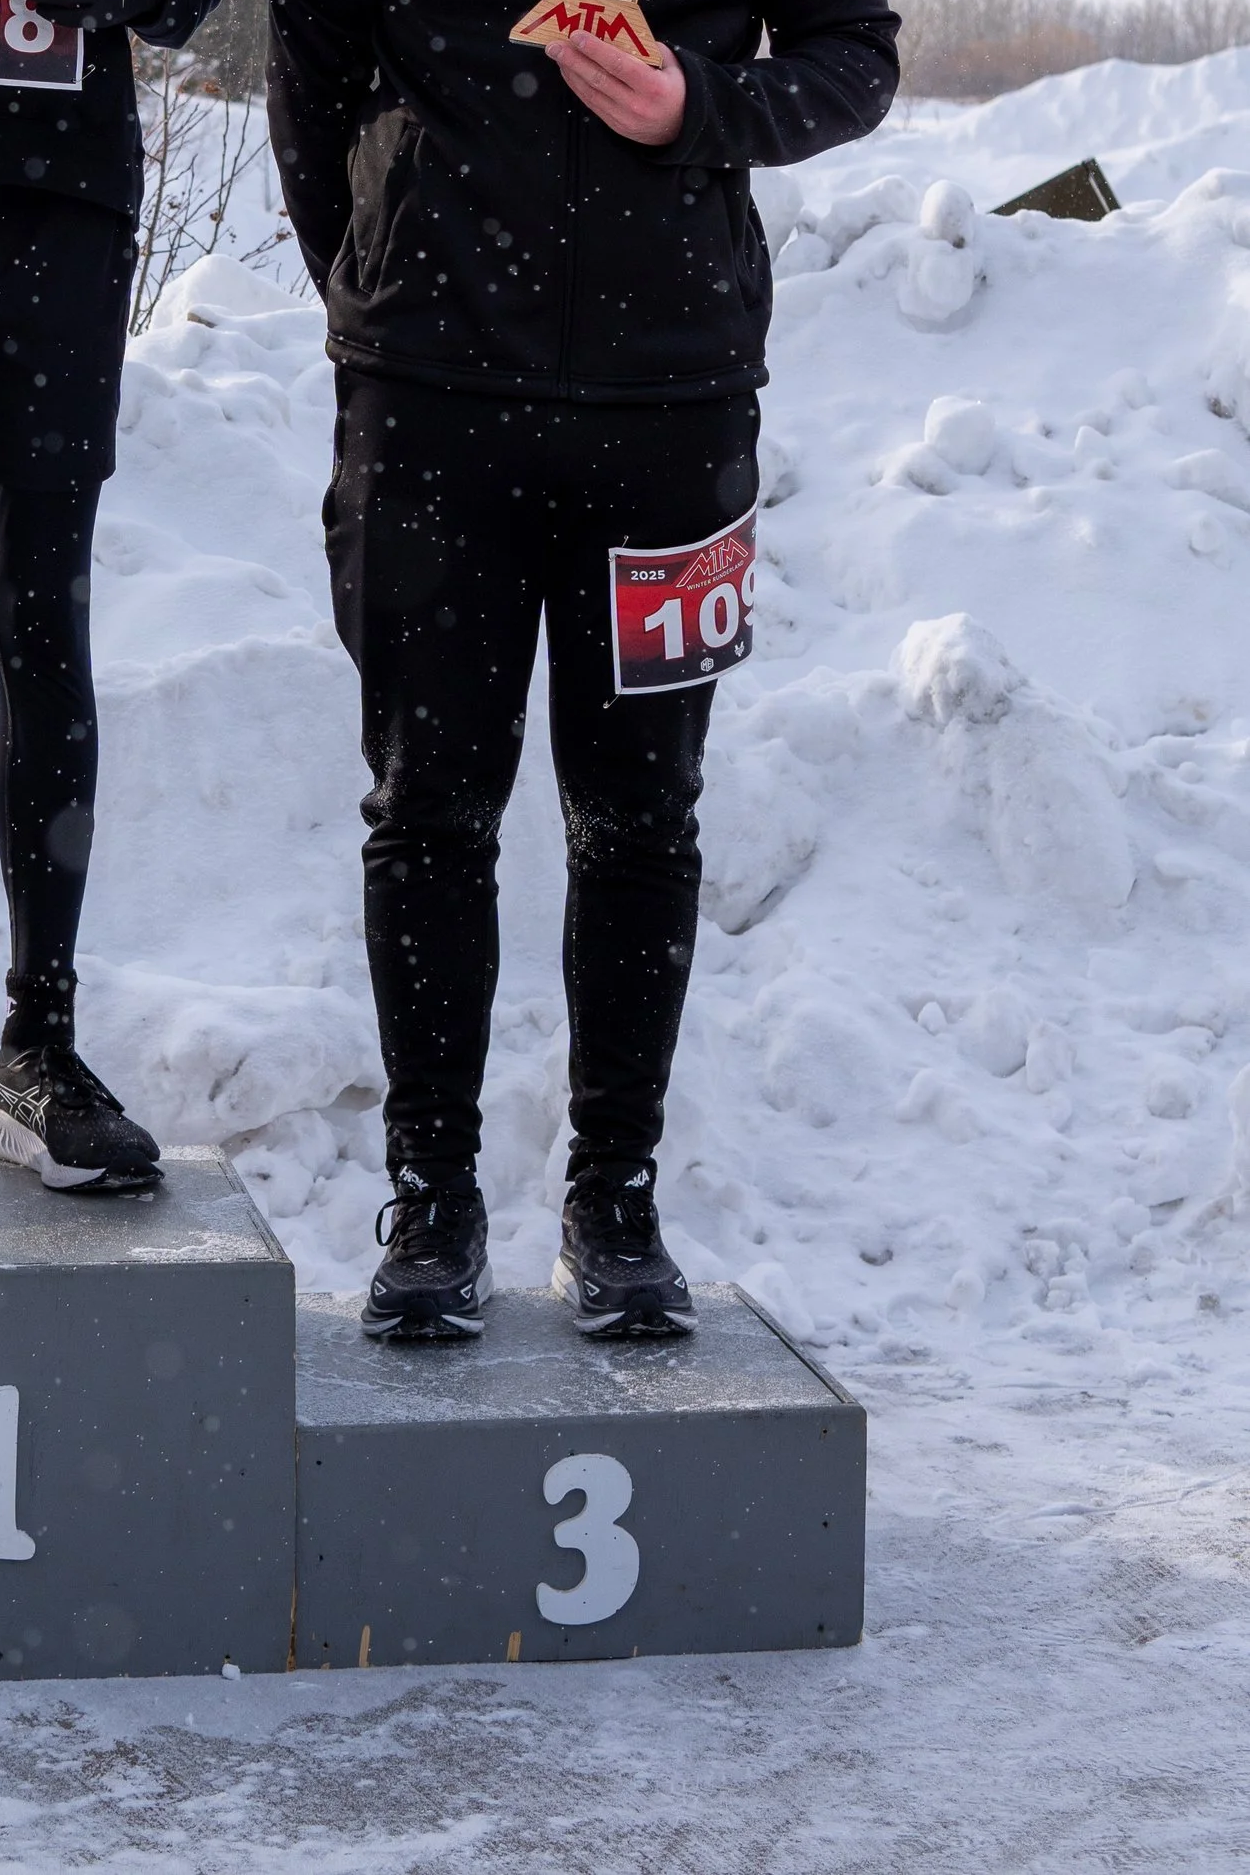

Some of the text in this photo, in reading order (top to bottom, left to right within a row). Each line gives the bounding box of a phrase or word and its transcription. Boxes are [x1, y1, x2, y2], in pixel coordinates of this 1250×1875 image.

[520, 1, 650, 57] MTM
[630, 570, 666, 581] 2025
[676, 536, 748, 588] MTM
[686, 560, 745, 590] WINTER RUNDERLAND
[535, 1453, 640, 1625] 3
